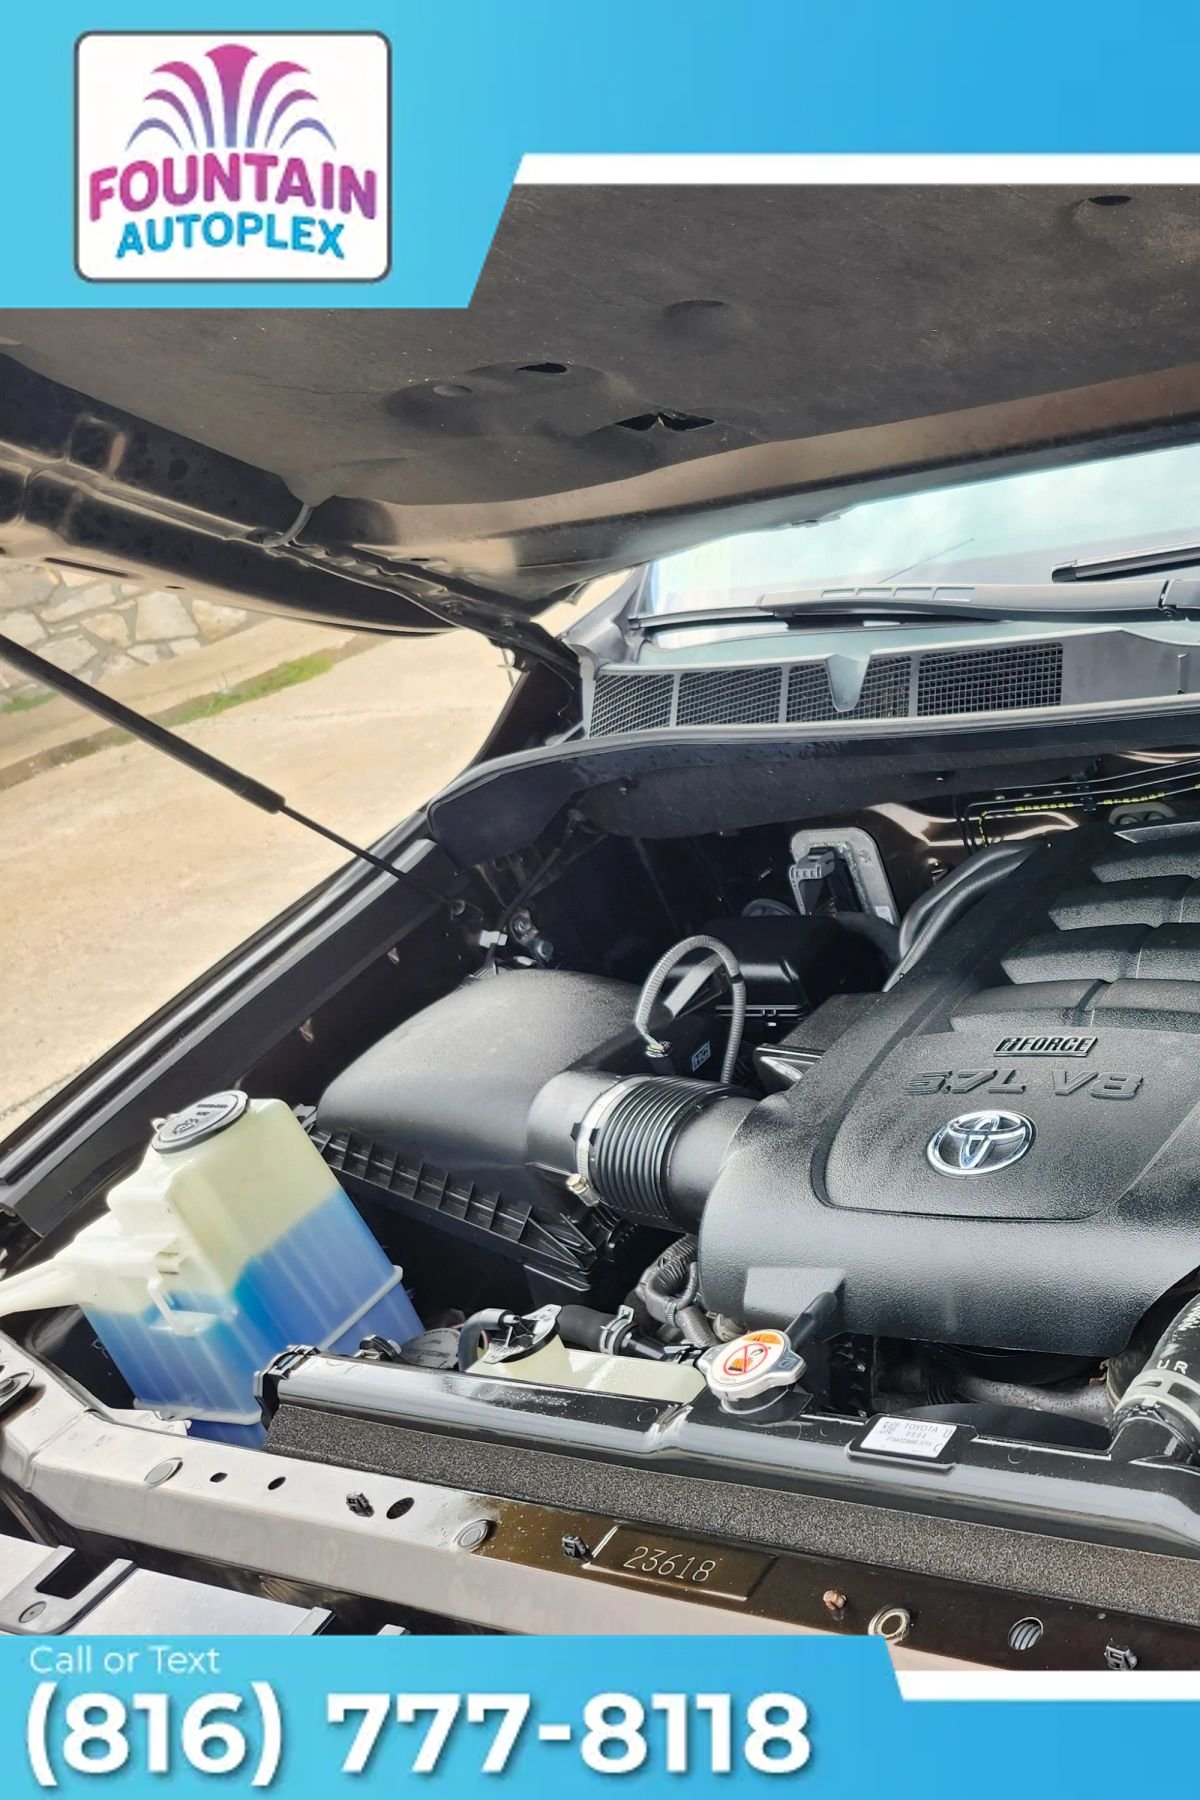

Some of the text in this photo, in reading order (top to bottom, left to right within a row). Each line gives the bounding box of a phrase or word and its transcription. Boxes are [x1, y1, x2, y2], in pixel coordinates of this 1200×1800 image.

[903, 1069, 1144, 1100] 5.7L V8
[904, 1423, 939, 1433] TOYOTA
[622, 1546, 717, 1583] 23618
